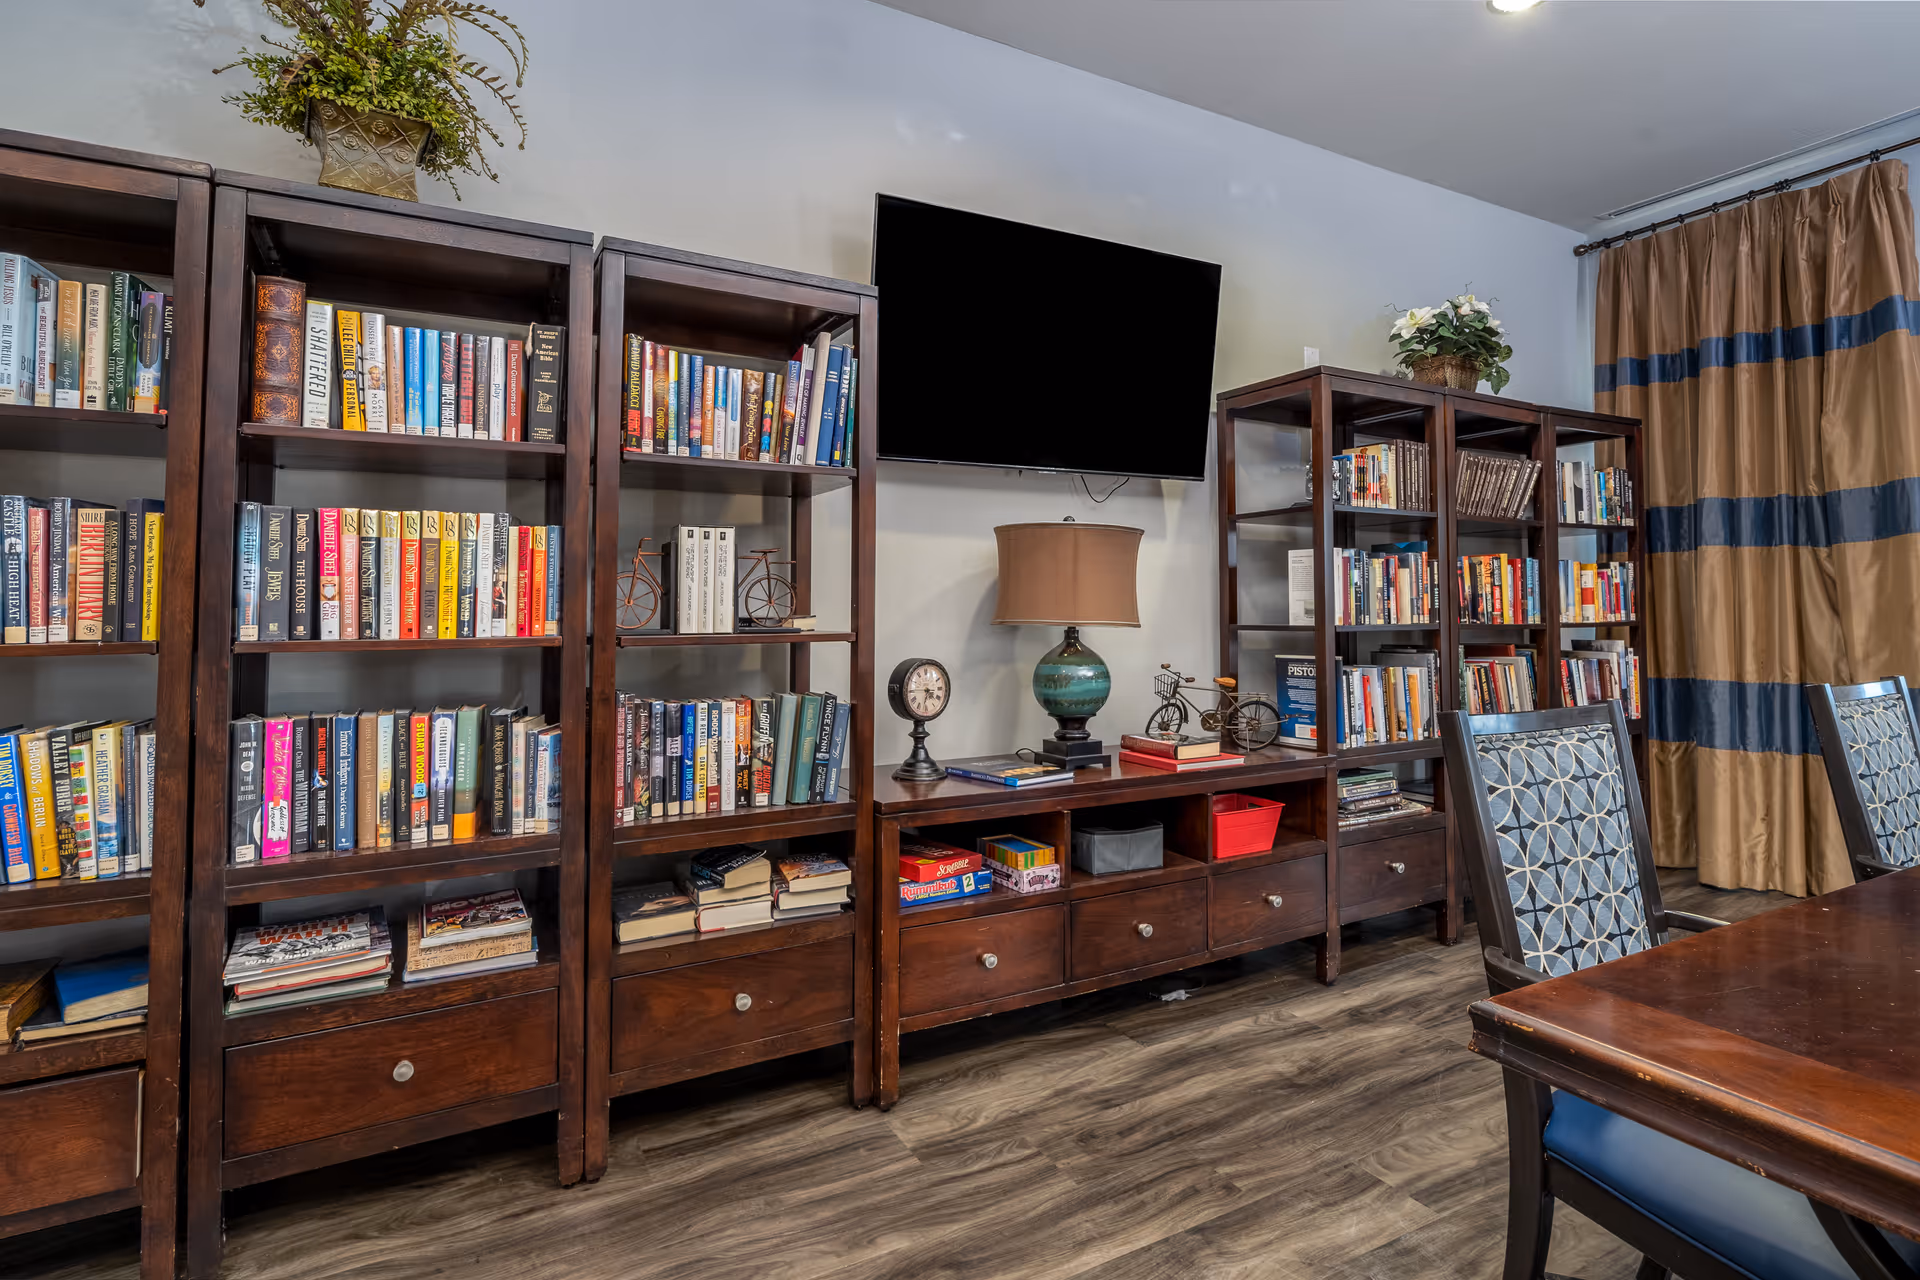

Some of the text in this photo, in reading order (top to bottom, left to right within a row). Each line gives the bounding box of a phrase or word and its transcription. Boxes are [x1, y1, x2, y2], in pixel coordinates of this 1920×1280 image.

[3, 258, 15, 305] KILLING JESUS
[2, 324, 12, 338] BILL
[112, 276, 124, 353] MARY HIGGINS CLARK
[164, 306, 173, 334] KLIMT
[368, 320, 376, 345] UNSEEN
[1, 340, 12, 367] O'REILLY
[64, 328, 72, 352] Dreams
[343, 328, 354, 366] LEE CHILD
[38, 350, 46, 390] BUREAUCRAT
[309, 327, 327, 398] SHATTERED
[630, 347, 640, 408] DAVID BALDACCI
[346, 383, 356, 418] PERSONAL
[442, 384, 455, 427] TRIPLE THREAT
[476, 384, 484, 431] UNHONORED
[492, 383, 502, 399] play
[4, 499, 14, 535] CASTLE
[129, 518, 137, 540] HOPE
[296, 514, 309, 553] DANIELLE STEEL
[32, 530, 40, 546] Bell
[53, 528, 61, 554] JINDAL
[268, 512, 284, 562] DANIELLE STEEL
[324, 512, 338, 575] DANIELLE STEEL
[481, 523, 491, 569] DANIELLE STEEL
[78, 525, 104, 622] BERLIN DIARY
[243, 569, 255, 590] PLAY
[362, 541, 376, 590] DANIELLE STEEL
[405, 542, 418, 584] DANIELLE STEEL
[425, 544, 438, 584] DANIELLE STEEL
[445, 546, 456, 582] DANIELLE STEEL
[462, 542, 476, 589] DANIELLE STEEL
[8, 560, 20, 620] HIGH HEAT
[52, 563, 61, 606] American
[128, 565, 136, 602] GORBACHEV
[265, 567, 284, 601] JEWELS
[295, 560, 305, 613] THE HOUSE
[345, 576, 355, 623] SAFE HARBOUR
[32, 601, 40, 625] LOVE
[322, 602, 330, 622] GIRL
[330, 604, 338, 619] BIG
[424, 590, 436, 618] ECHOES
[442, 586, 454, 622] IMPOSSIBLE
[340, 730, 351, 756] Emotional
[492, 725, 504, 764] NORA ROBERTS
[760, 713, 770, 742] GRIFFIN
[820, 699, 833, 752] VINCE FLYNN
[416, 723, 424, 783] STUART WOODS
[439, 726, 447, 768] TECHNOLOGISTS
[670, 738, 681, 754] ALEX
[0, 760, 14, 788] DORSEY
[28, 741, 46, 827] SHADOWS BERLIN
[52, 736, 72, 812] VALLEY FORGE
[96, 750, 110, 815] HEATHER GRAHAM
[495, 772, 504, 799] MIDNIGHT
[295, 770, 308, 833] THE WATCHMAN
[3, 804, 24, 865] CLOWNFISH BLUE
[937, 858, 969, 876] SCRABBLE
[965, 876, 972, 888] 2
[901, 879, 957, 901] Rummikub
